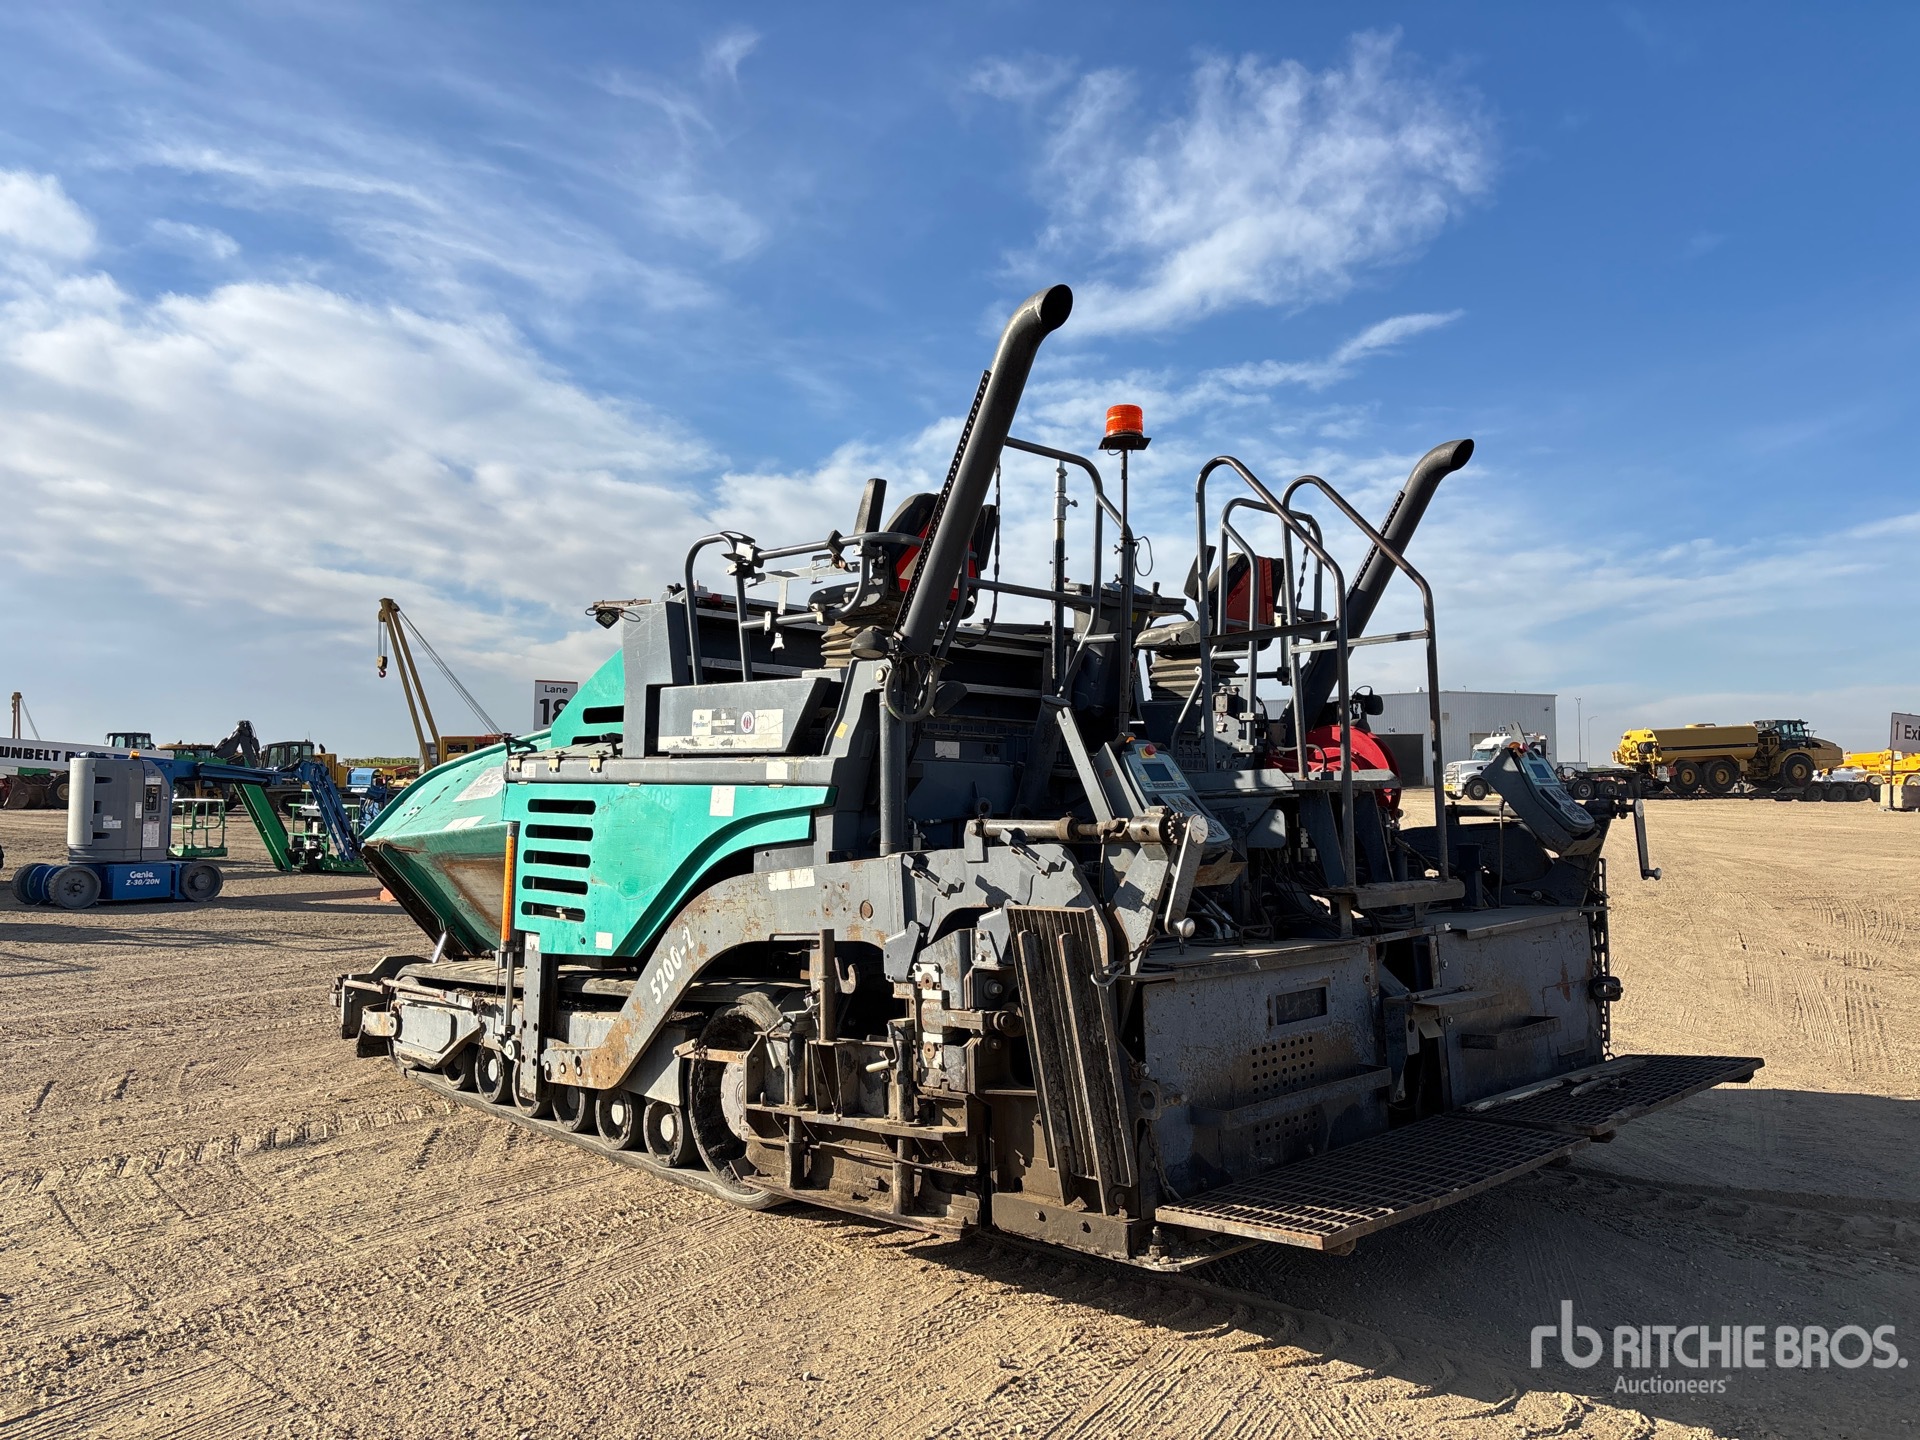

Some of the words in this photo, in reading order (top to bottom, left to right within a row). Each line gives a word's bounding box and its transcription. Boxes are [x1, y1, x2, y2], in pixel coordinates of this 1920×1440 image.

[544, 684, 568, 694] Lane
[129, 870, 154, 879] Genie
[125, 878, 161, 886] Z-30/20N
[649, 926, 695, 1005] 5200-2
